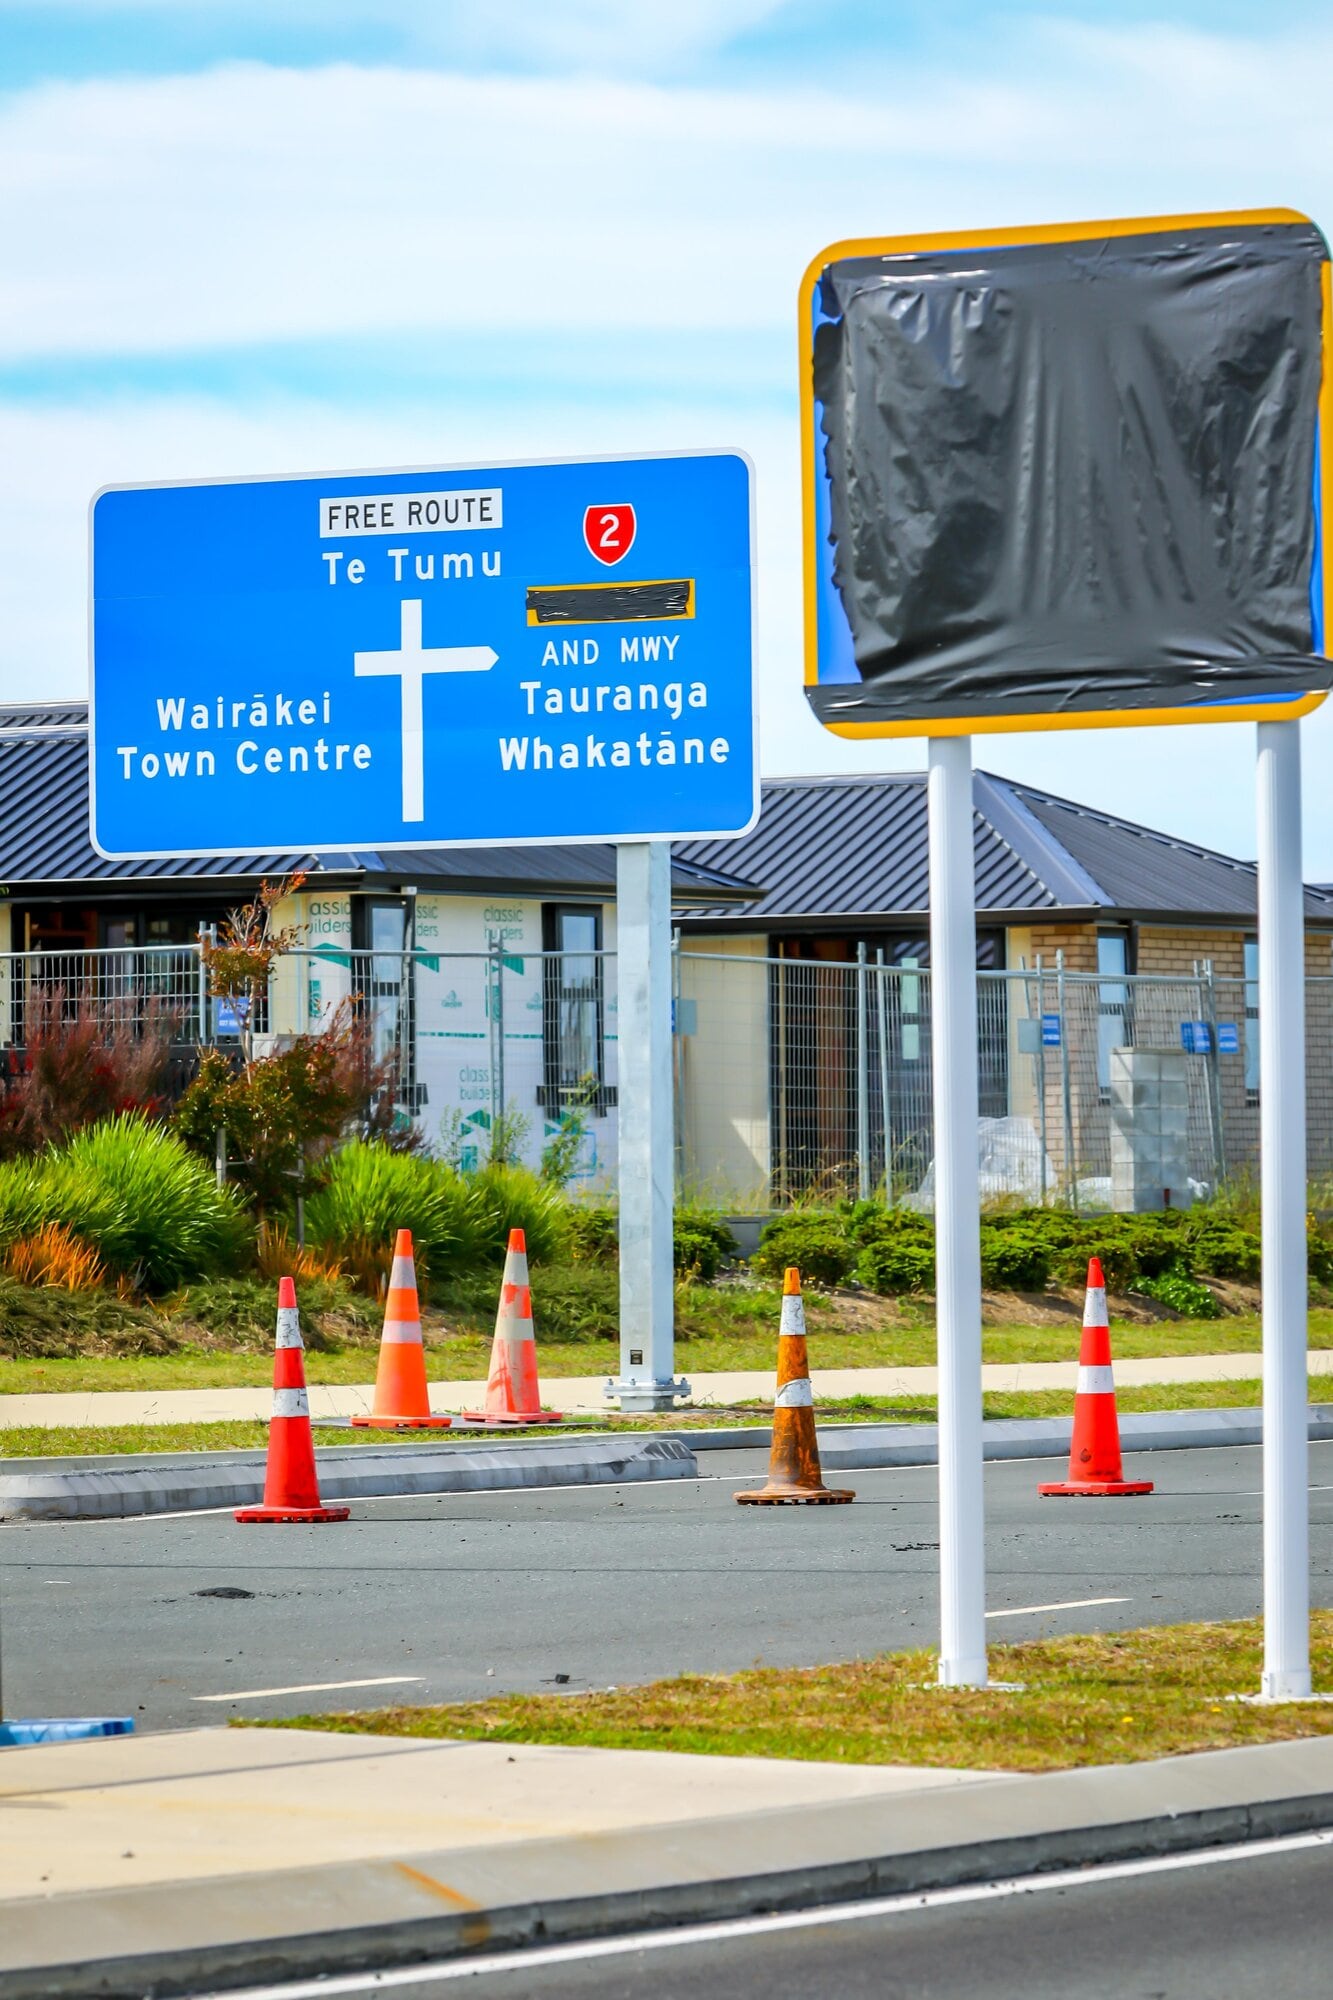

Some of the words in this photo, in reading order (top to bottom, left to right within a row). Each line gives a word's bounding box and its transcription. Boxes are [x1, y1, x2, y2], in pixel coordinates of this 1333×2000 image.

[328, 503, 394, 530] FREE
[409, 497, 494, 525] ROUTE
[599, 513, 620, 548] 2
[322, 551, 366, 585] Te
[388, 548, 502, 581] Tumu
[541, 639, 600, 666] AND
[621, 635, 681, 663] MWY
[156, 691, 331, 731] Wairākei
[519, 681, 708, 720] Tauranga
[117, 746, 216, 779] Town
[236, 738, 372, 775] Centre
[499, 731, 730, 771] Whakatāne
